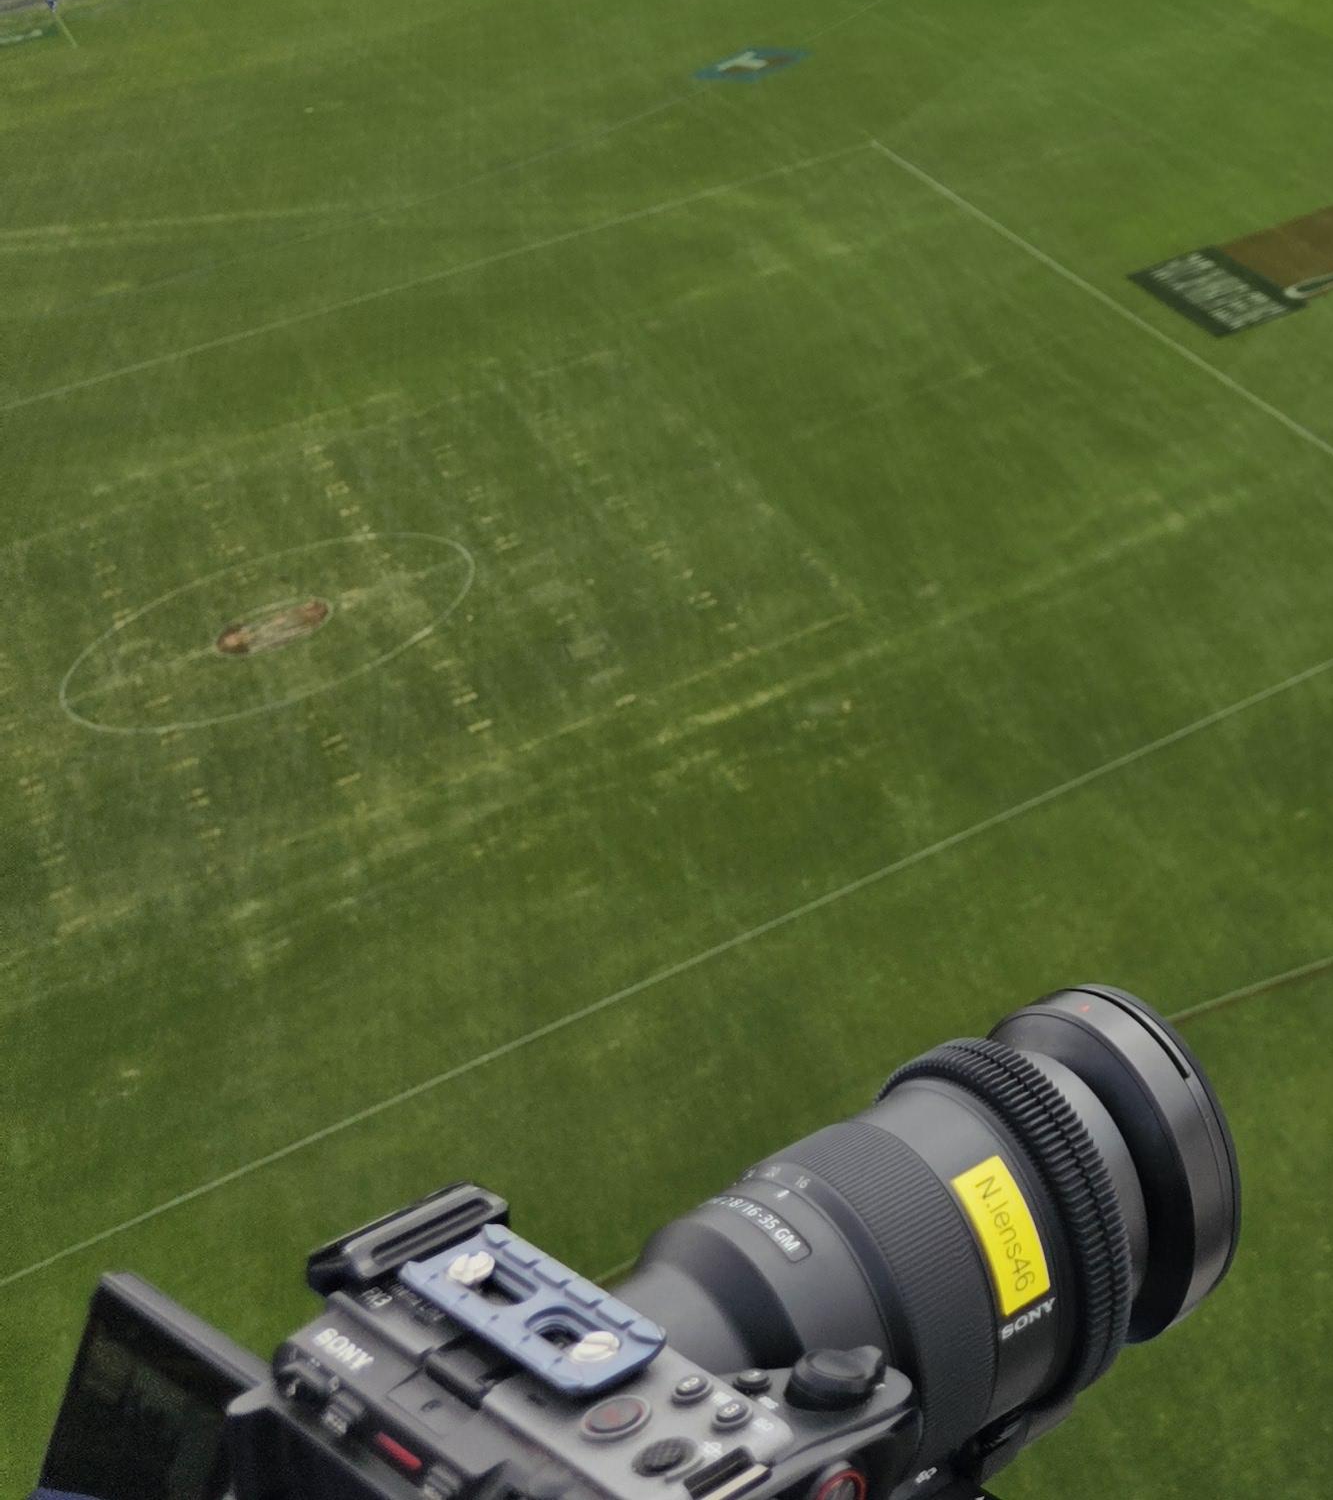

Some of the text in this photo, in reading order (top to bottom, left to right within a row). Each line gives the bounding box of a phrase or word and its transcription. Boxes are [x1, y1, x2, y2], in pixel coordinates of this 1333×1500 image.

[773, 1227, 802, 1253] GM
[1001, 1296, 1056, 1341] SONY
[313, 1327, 375, 1371] SONY
